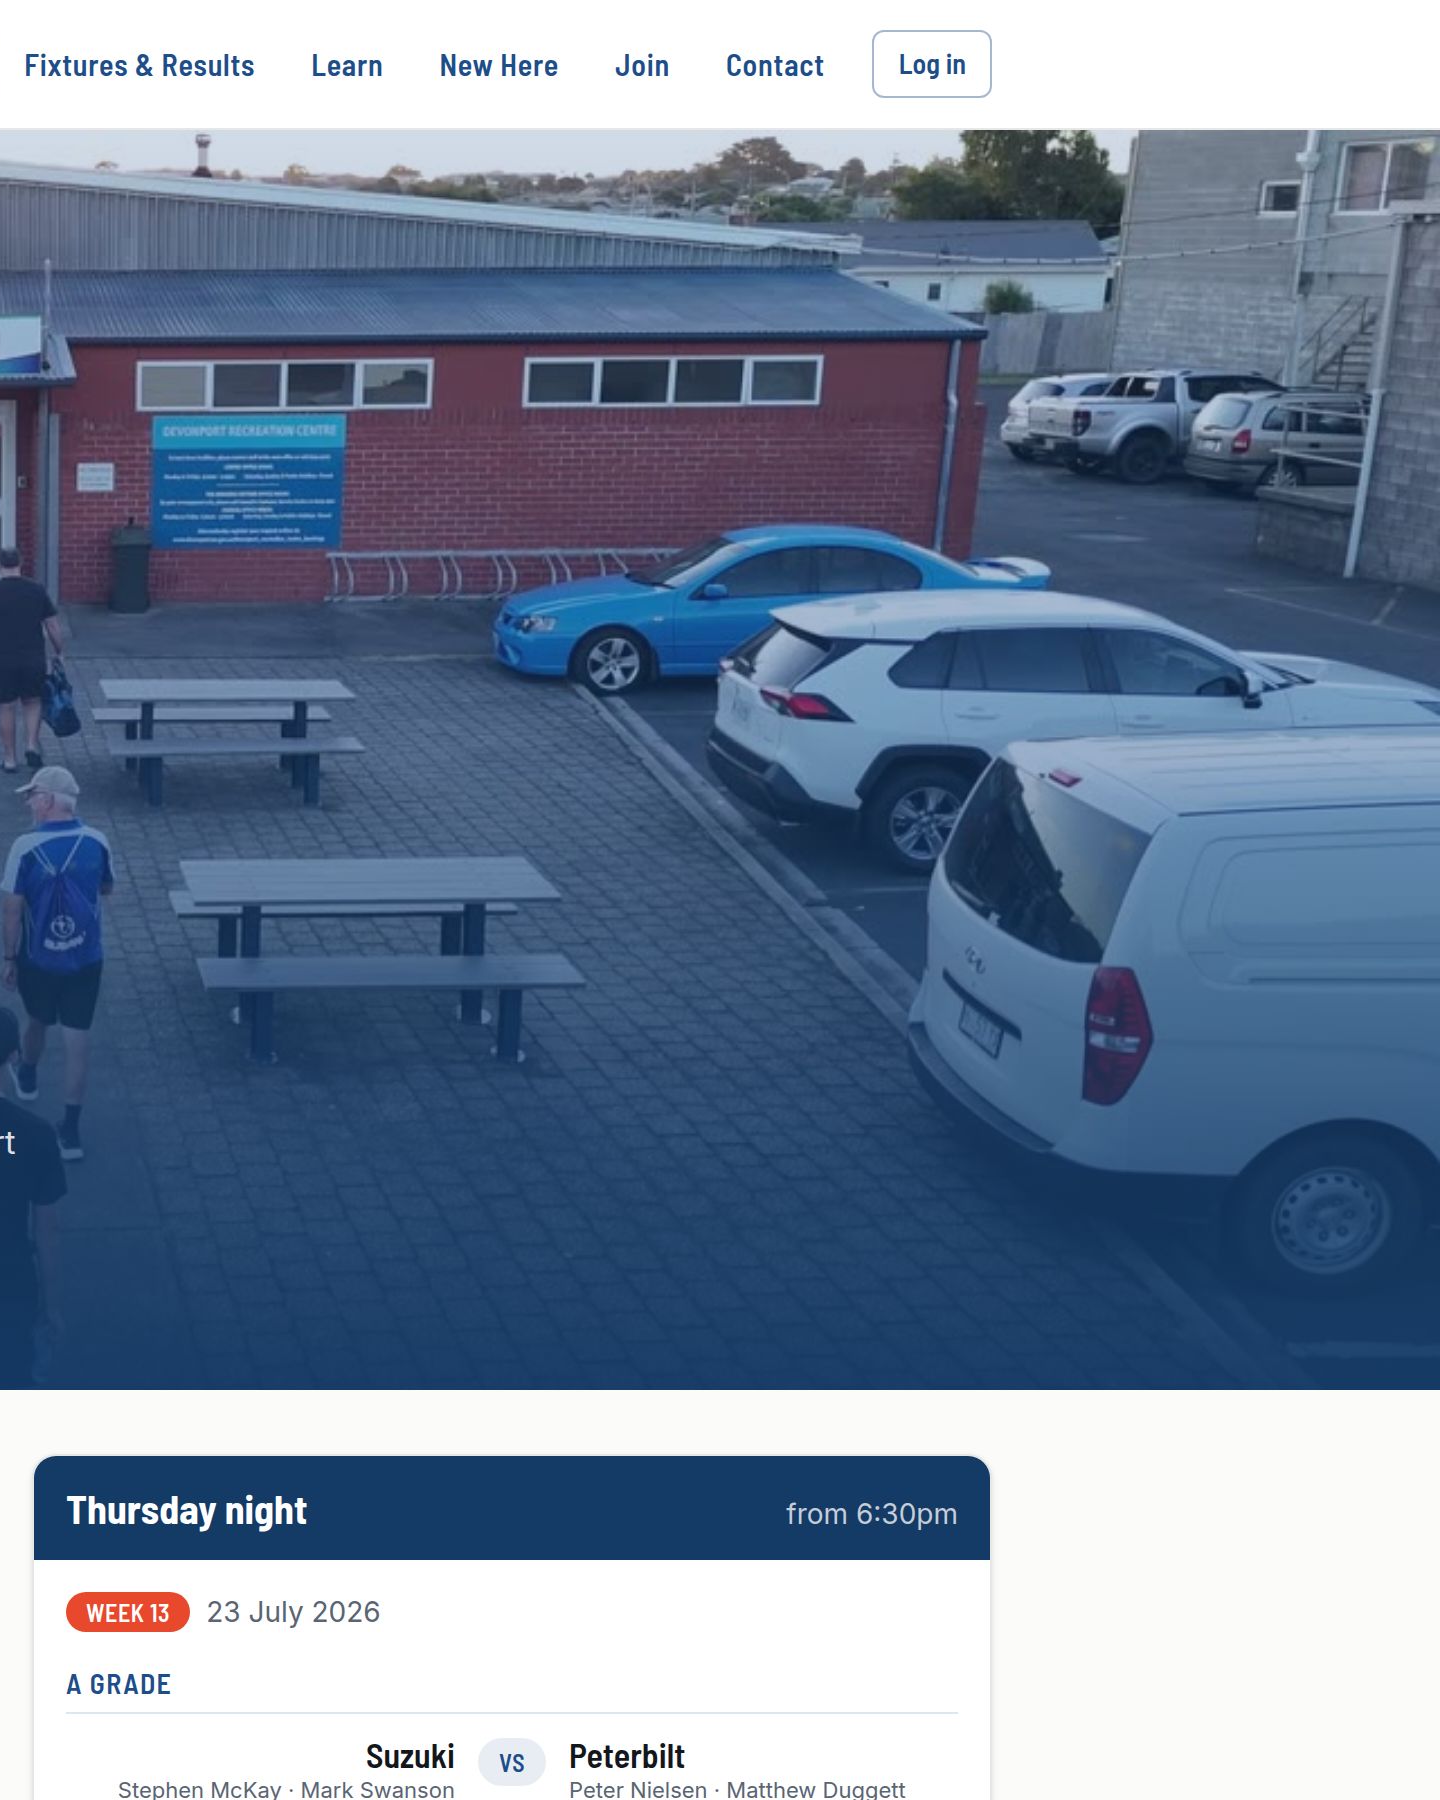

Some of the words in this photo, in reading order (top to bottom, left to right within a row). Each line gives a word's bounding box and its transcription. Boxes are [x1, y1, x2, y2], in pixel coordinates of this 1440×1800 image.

[25, 52, 128, 77] Fixtures
[135, 53, 154, 77] &
[162, 53, 255, 77] Results
[312, 53, 383, 77] Learn
[440, 53, 494, 77] New
[501, 53, 559, 77] Here
[615, 52, 669, 77] Join
[726, 53, 825, 77] Contact
[899, 53, 940, 80] Log
[946, 52, 966, 75] in
[162, 426, 227, 437] DEVONPORT
[228, 425, 294, 437] RECREATION
[296, 424, 337, 437] CENTRE
[66, 1495, 217, 1533] Thursday
[225, 1494, 308, 1533] night
[785, 1501, 847, 1525] from
[857, 1502, 957, 1531] 6:30pm
[85, 1603, 144, 1623] WEEK
[149, 1603, 170, 1623] 13
[207, 1600, 240, 1623] 23
[249, 1600, 304, 1629] July
[312, 1600, 380, 1623] 2026
[66, 1673, 82, 1695] A
[90, 1673, 171, 1695] GRADE
[366, 1742, 455, 1769] Suzuki
[499, 1753, 525, 1773] VS
[569, 1742, 686, 1769] Peterbilt
[118, 1781, 204, 1800] Stephen
[211, 1781, 282, 1800] McKay
[301, 1781, 354, 1799] Mark
[360, 1781, 455, 1799] Swanson
[570, 1781, 625, 1799] Peter
[631, 1780, 707, 1799] Nielsen
[727, 1781, 817, 1799] Matthew
[823, 1781, 906, 1800] Duggett
